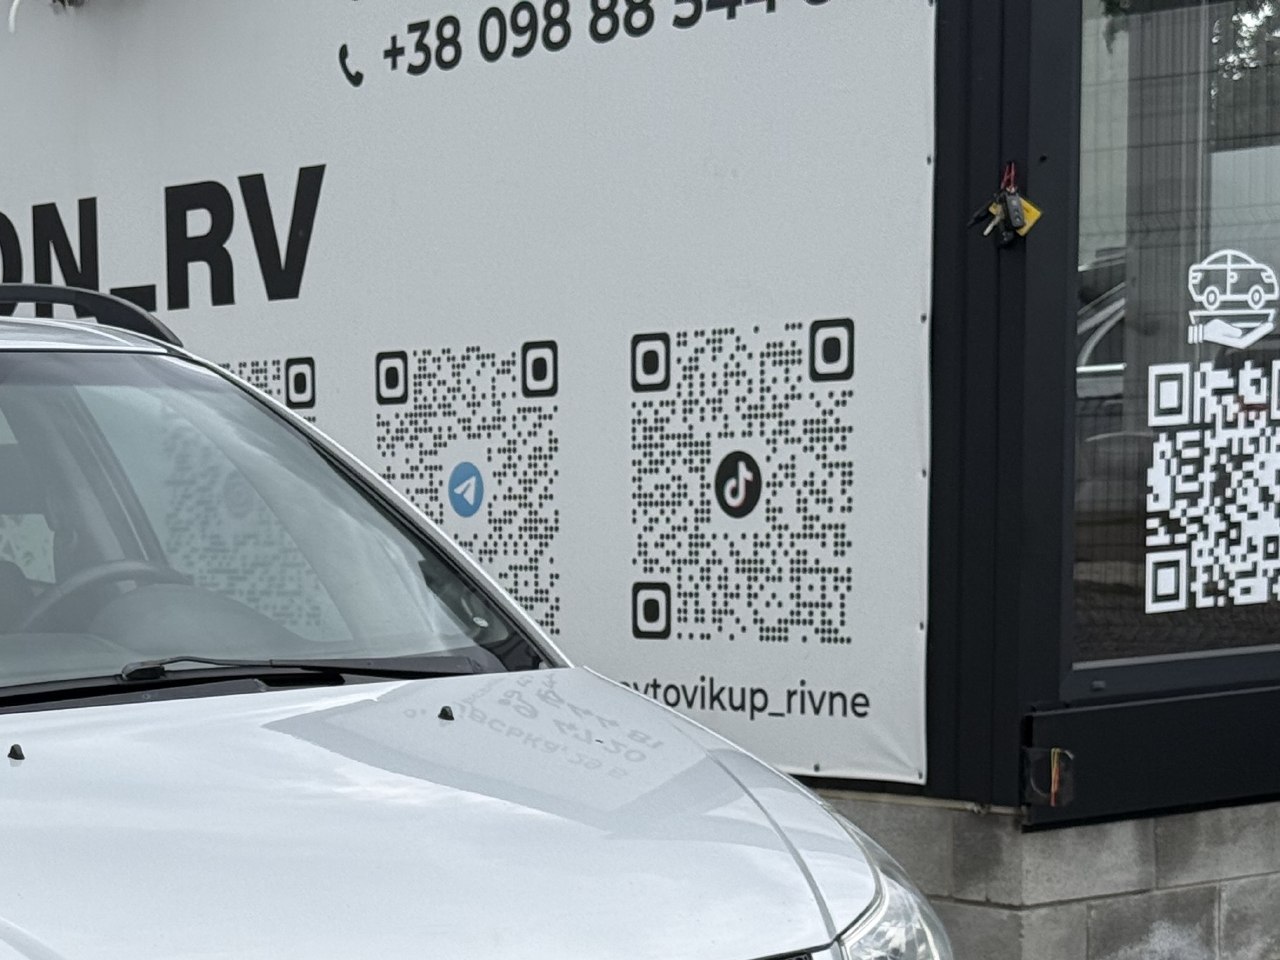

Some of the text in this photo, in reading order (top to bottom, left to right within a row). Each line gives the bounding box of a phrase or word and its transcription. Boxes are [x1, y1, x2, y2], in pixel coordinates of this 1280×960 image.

[383, 15, 462, 76] +38
[478, 0, 572, 62] 098
[588, 0, 655, 43] 88
[620, 676, 870, 720] vtovikup_rivne
